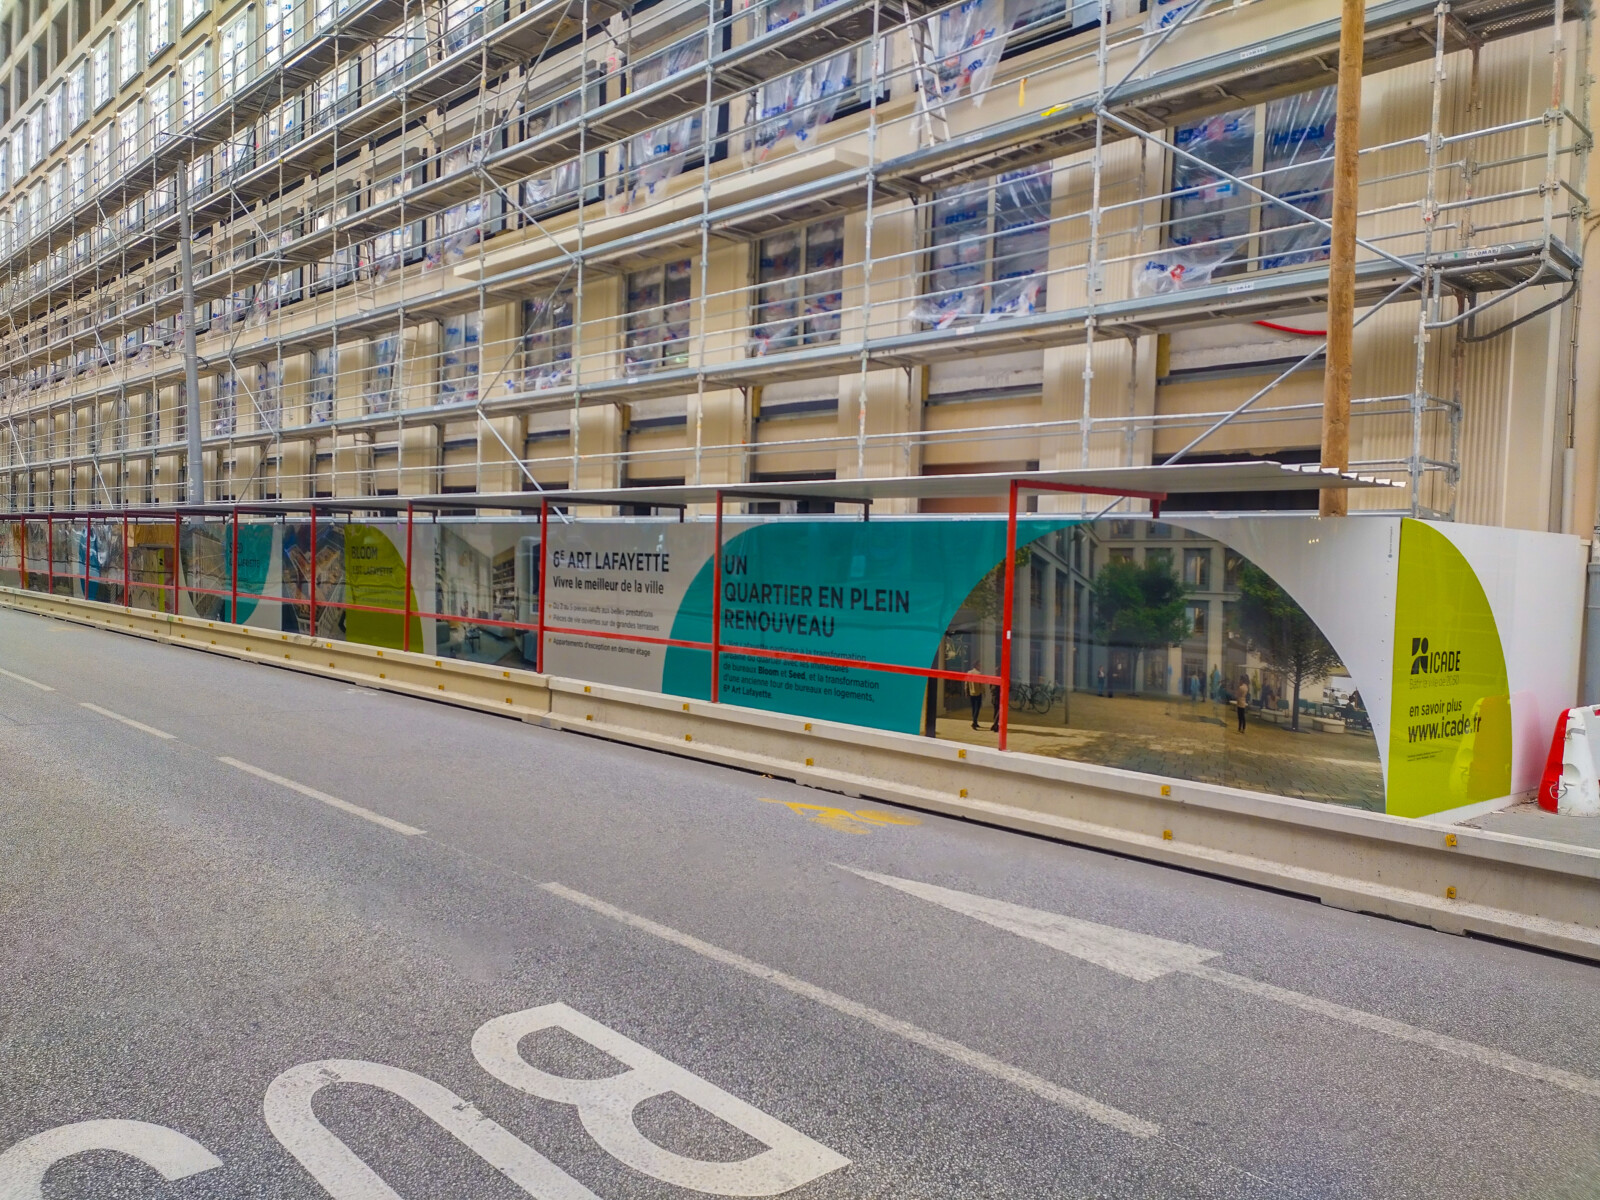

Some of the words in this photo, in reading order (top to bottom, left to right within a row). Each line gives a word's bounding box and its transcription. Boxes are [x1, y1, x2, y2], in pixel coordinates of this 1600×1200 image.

[352, 546, 378, 560] BLOOM
[568, 552, 592, 570] ART
[595, 552, 670, 572] LAFAYETTE
[724, 554, 748, 575] UN
[553, 576, 574, 589] Vivre
[575, 577, 582, 590] le
[584, 578, 618, 592] meilleur
[621, 579, 632, 592] de
[634, 580, 643, 593] la
[646, 581, 664, 594] ville
[724, 582, 812, 607] QUARTIER
[819, 586, 844, 608] EN
[851, 588, 910, 613] PLEIN
[626, 609, 654, 618] prestations
[616, 620, 636, 629] grandes
[636, 622, 659, 631] terrasses
[724, 610, 834, 638] RENOUVEAU
[553, 638, 583, 648] Appartements
[584, 641, 610, 652] d'exception
[618, 646, 635, 654] dernier
[1430, 651, 1461, 674] ICADE
[732, 664, 757, 674] bureaux
[758, 666, 779, 676] Bloom
[781, 670, 787, 678] et
[809, 673, 816, 682] et
[818, 674, 824, 682] la
[825, 675, 880, 689] transformation
[723, 674, 740, 683] d'une
[741, 676, 768, 687] ancienne
[770, 680, 783, 688] tour
[784, 682, 793, 690] de
[794, 682, 822, 694] bureaux
[834, 688, 875, 703] logements,
[732, 685, 741, 694] Art
[1410, 705, 1419, 717] en
[1421, 700, 1445, 715] savoir
[1447, 698, 1462, 715] plus
[1408, 712, 1481, 743] www.icade.fr
